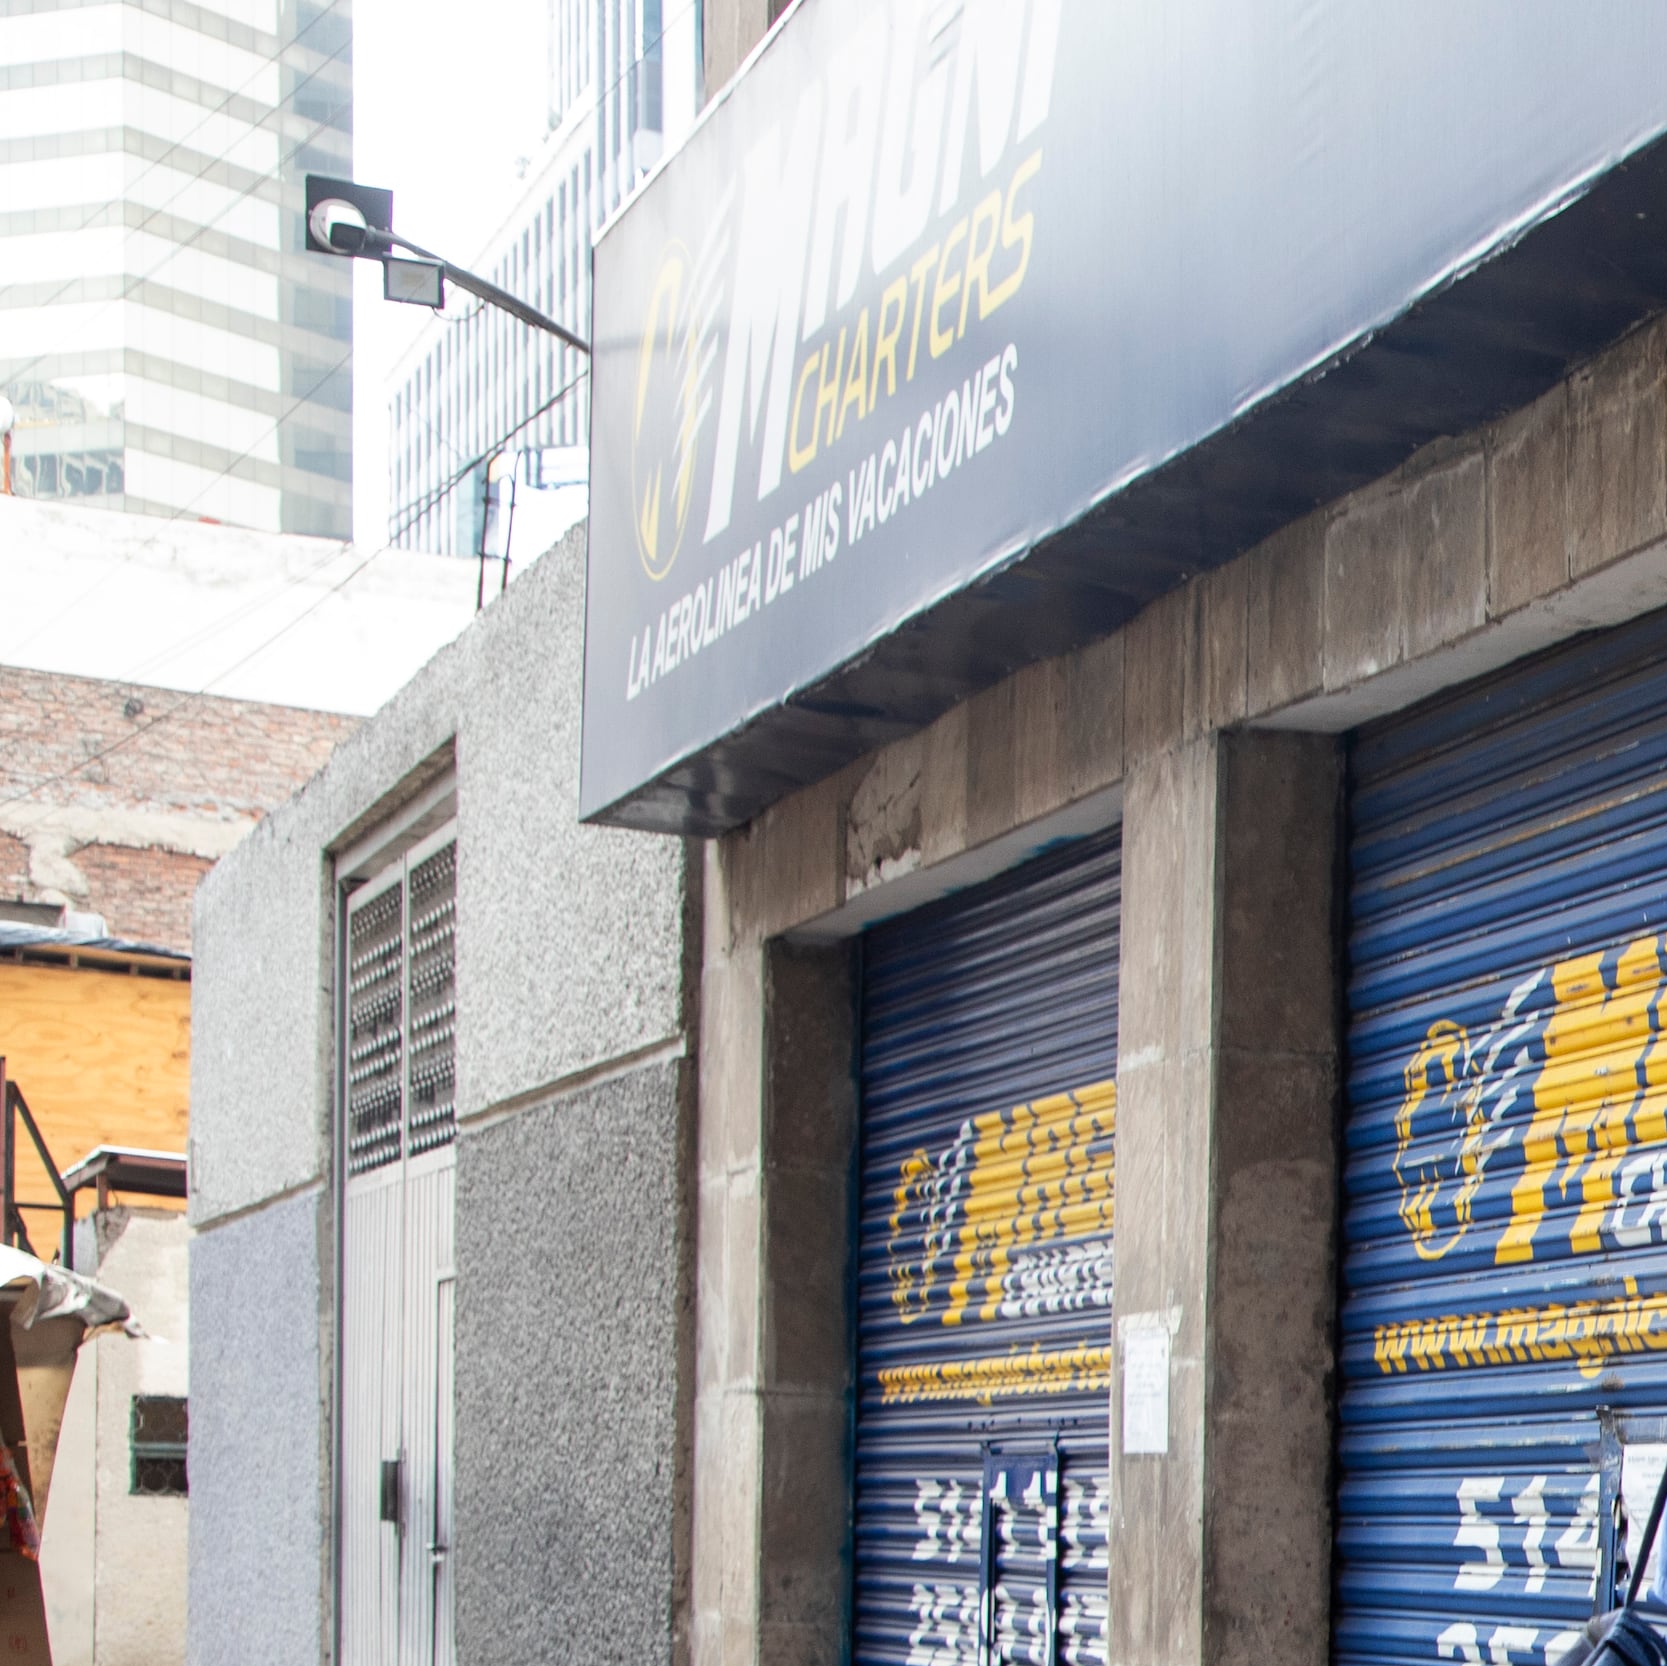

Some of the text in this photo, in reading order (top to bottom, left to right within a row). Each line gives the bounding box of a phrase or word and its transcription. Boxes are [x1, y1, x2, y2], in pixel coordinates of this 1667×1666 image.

[788, 148, 1043, 474] CHARTERS
[626, 342, 1019, 702] LA AEROLINEA DE MIS VACACIONES
[1453, 1473, 1604, 1601] 514
